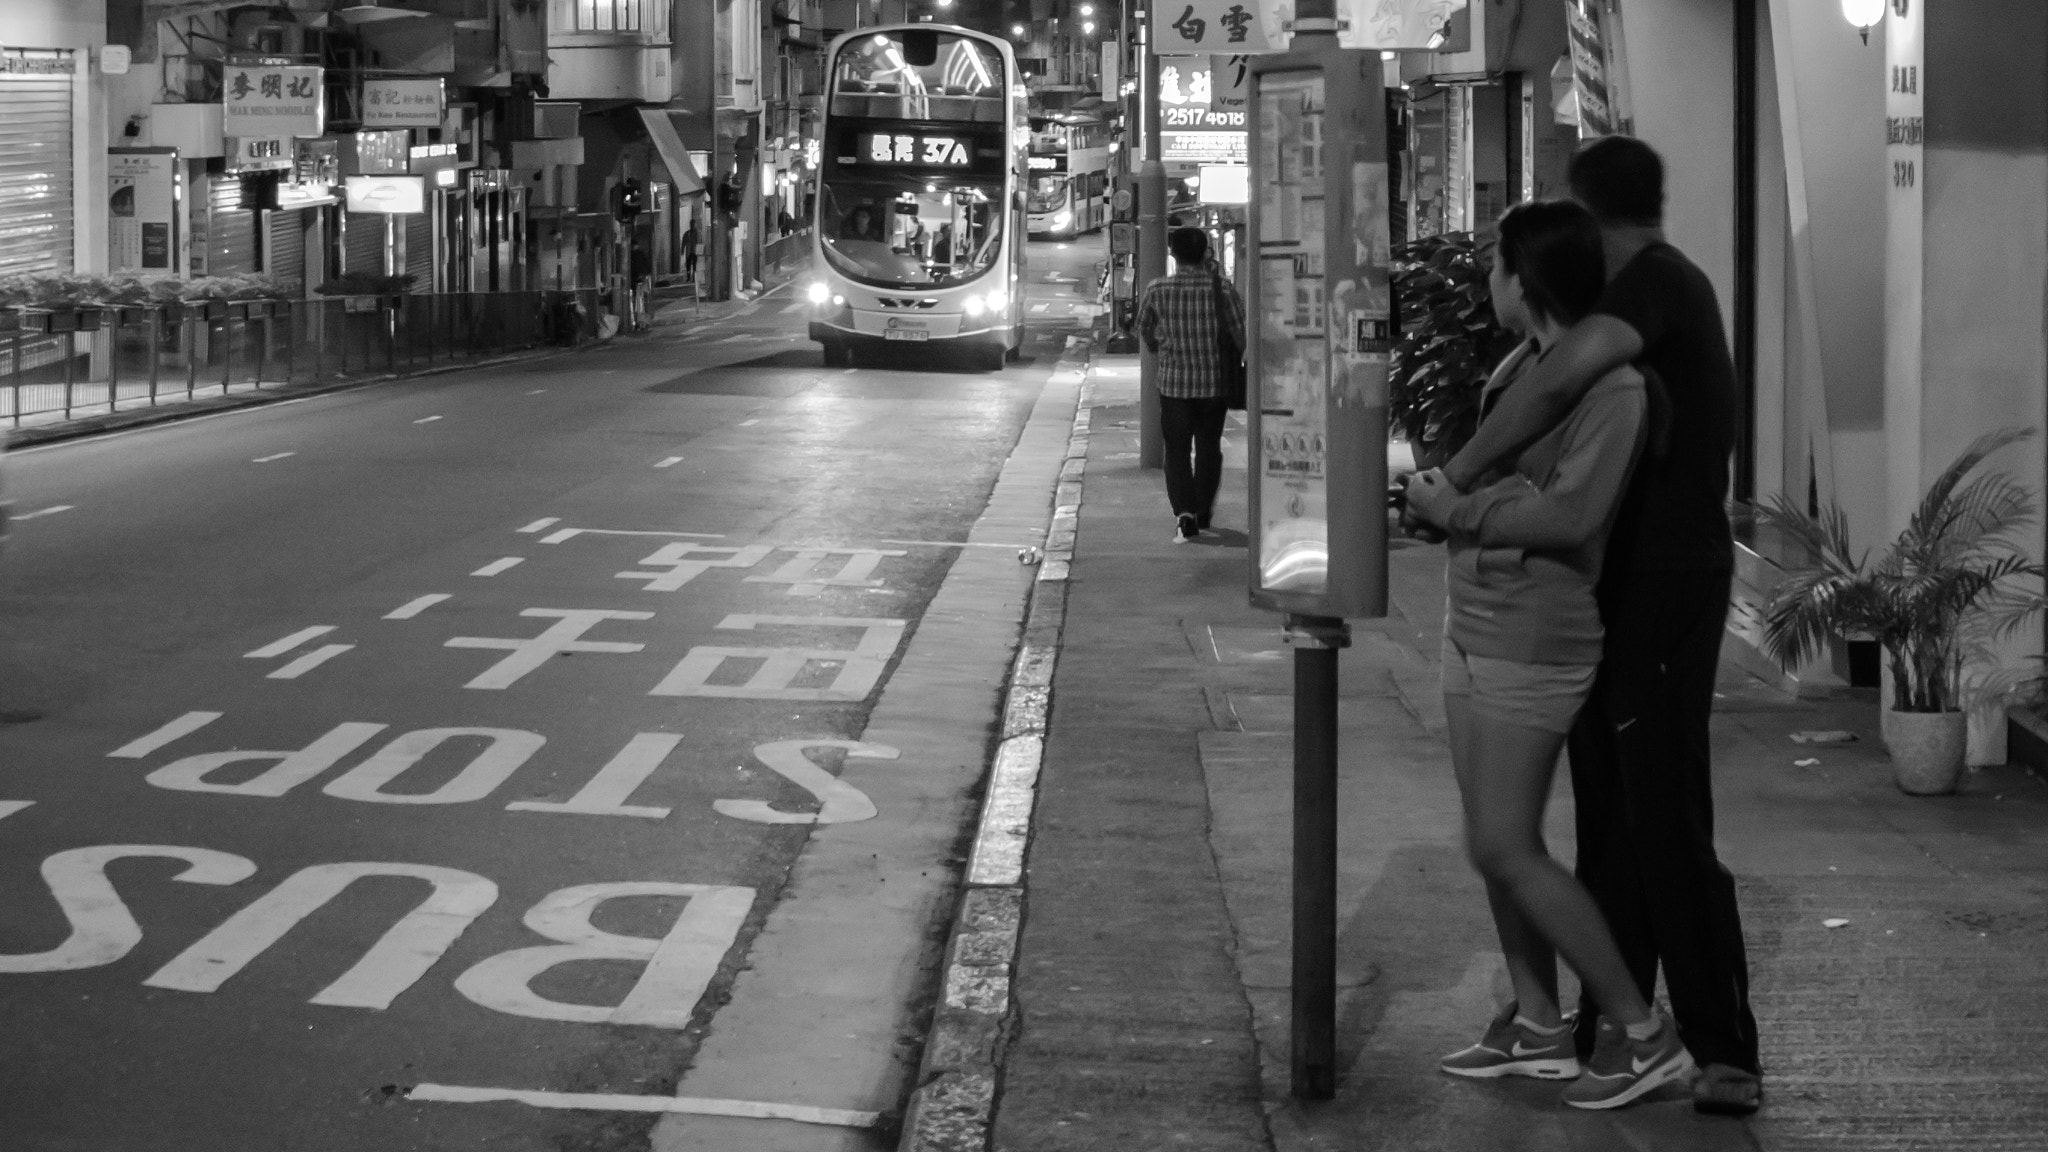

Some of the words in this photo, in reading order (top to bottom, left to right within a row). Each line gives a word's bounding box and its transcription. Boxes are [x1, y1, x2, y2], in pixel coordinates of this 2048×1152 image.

[1172, 4, 1253, 43] 白雪
[230, 72, 314, 100] 麥明記
[276, 106, 314, 115] NOODLES
[1167, 107, 1204, 125] 2517
[922, 137, 968, 164] 37A
[1893, 161, 1914, 188] 320
[614, 542, 907, 597] 站
[443, 607, 906, 702] 巴士
[145, 721, 900, 824] STOP
[0, 843, 756, 1029] BUS
